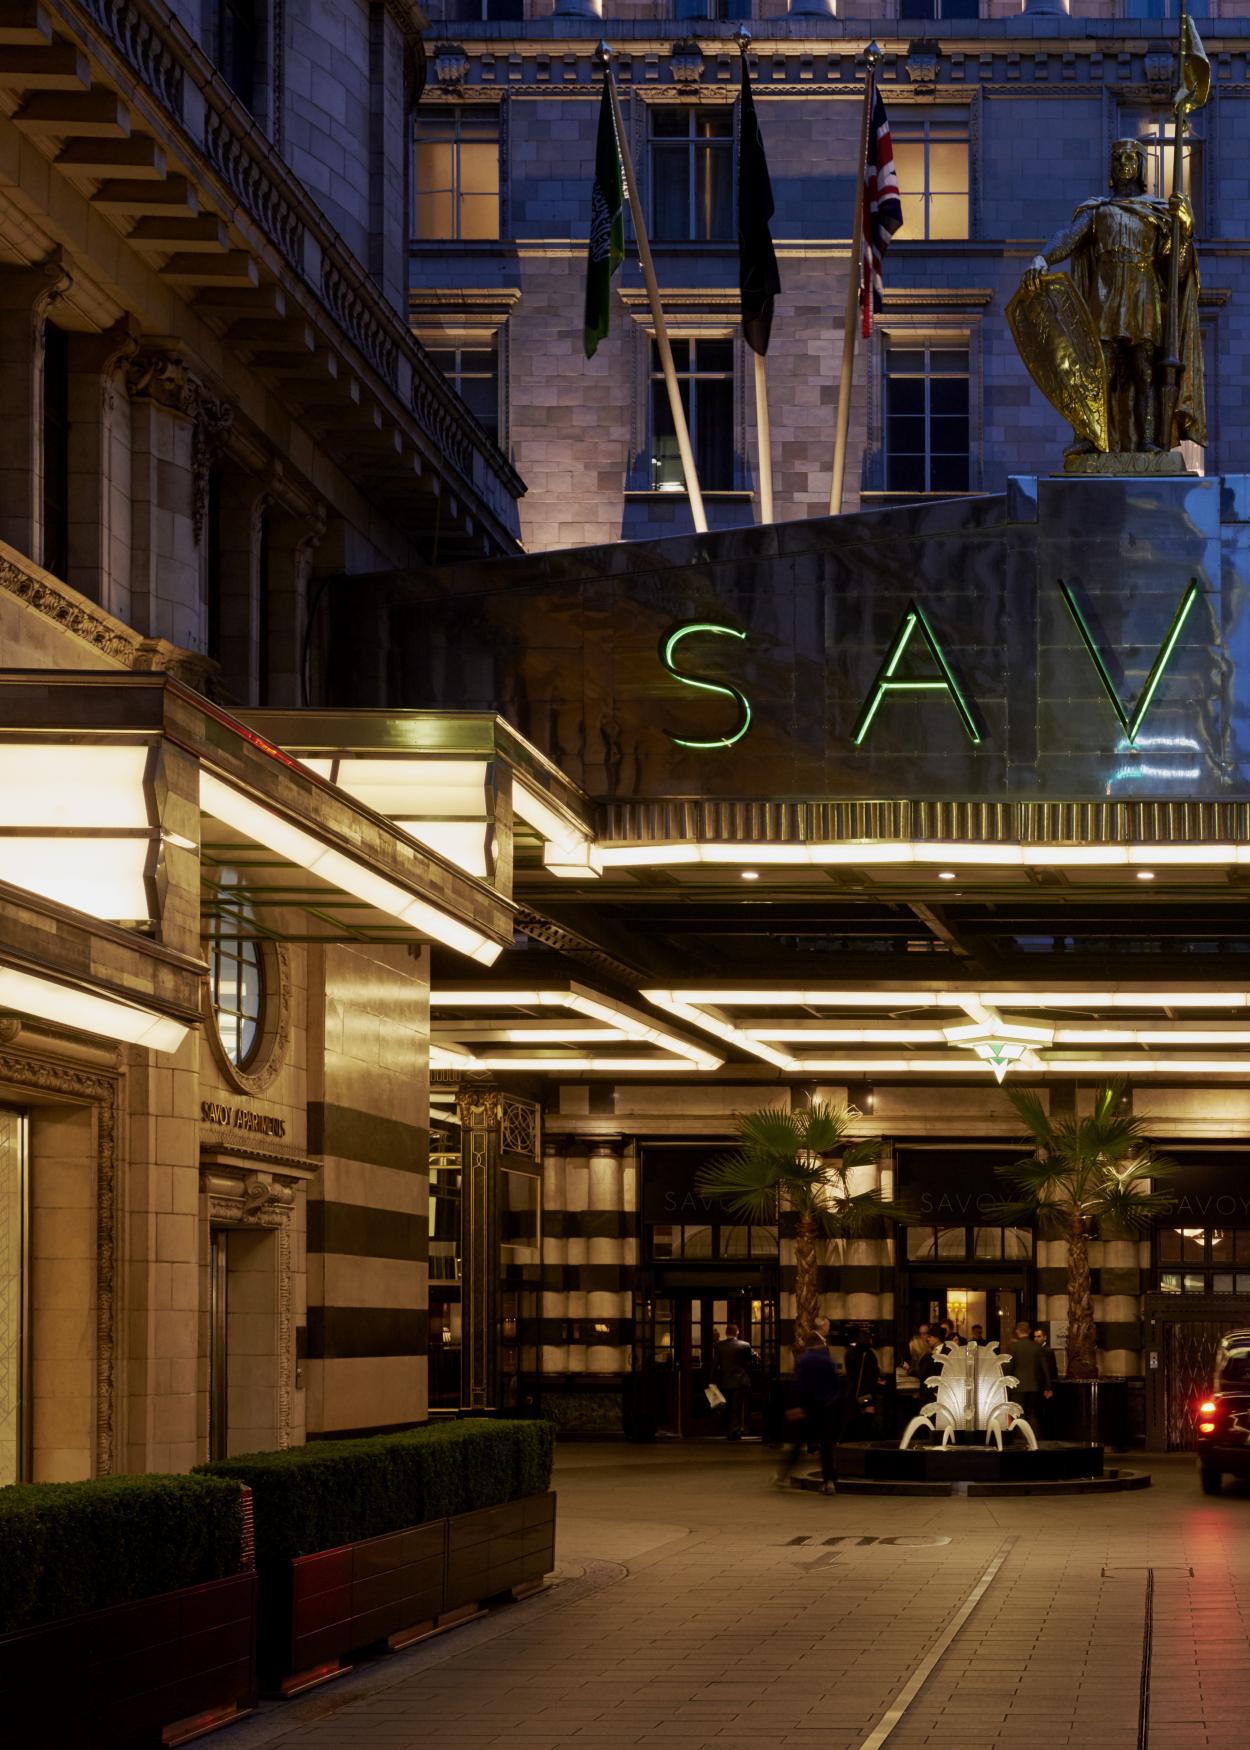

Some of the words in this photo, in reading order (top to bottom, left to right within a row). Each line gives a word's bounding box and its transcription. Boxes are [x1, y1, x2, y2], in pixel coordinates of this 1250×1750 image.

[200, 1100, 233, 1126] SAVOY
[234, 1107, 286, 1138] APARTMENTS
[663, 1191, 729, 1212] SAV
